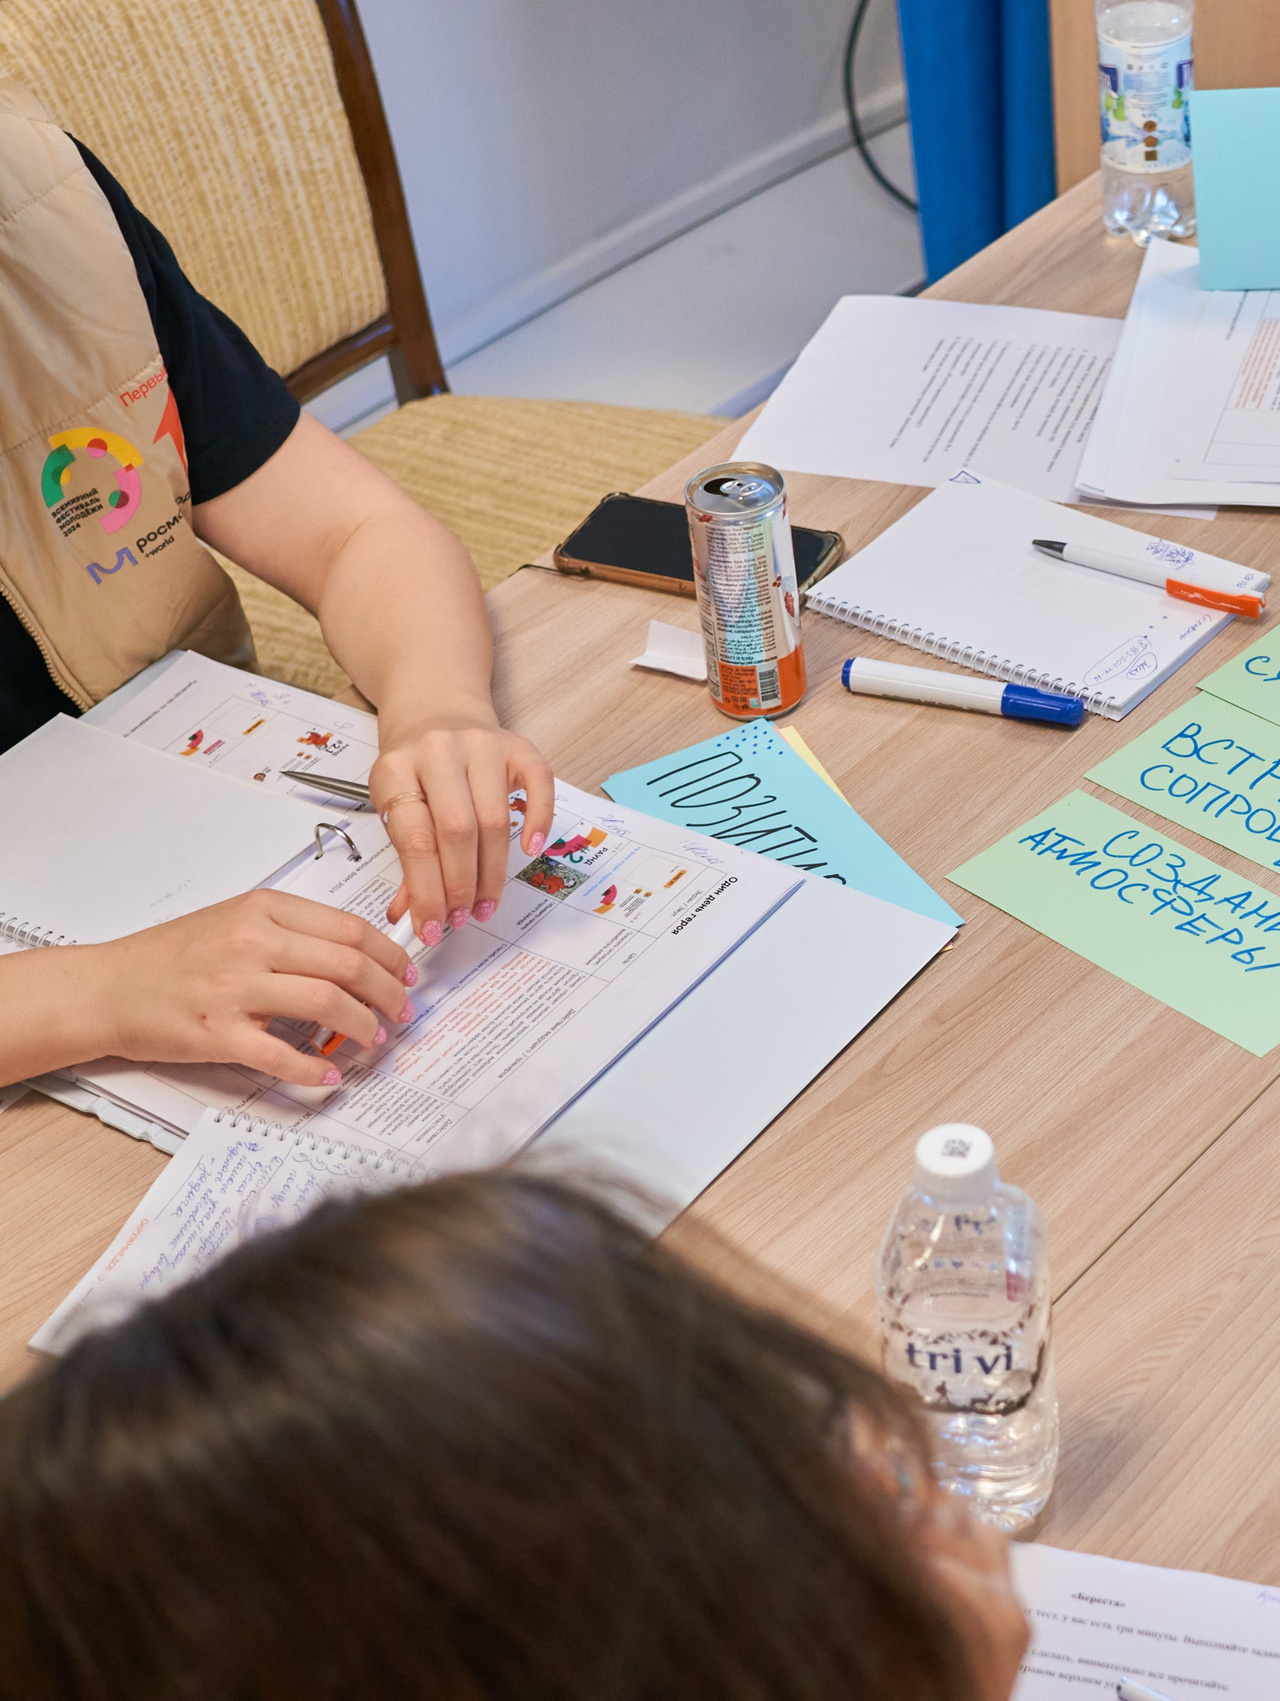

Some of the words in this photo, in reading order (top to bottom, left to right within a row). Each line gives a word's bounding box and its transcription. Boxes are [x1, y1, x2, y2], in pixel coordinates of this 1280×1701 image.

[51, 488, 99, 518] ВСЕМИРНЫЙ
[55, 497, 101, 524] ФЕСТИВАЛЬ
[58, 504, 104, 531] МОЛОДЁЖИ
[63, 522, 82, 538] 2024
[582, 846, 609, 865] РАУНД
[326, 881, 345, 894] 2024
[711, 875, 739, 895] Один
[684, 889, 704, 903] Экран
[691, 894, 718, 913] день
[668, 906, 685, 917] Звук
[667, 912, 698, 935] героя
[1070, 1589, 1126, 1611] «Береста»
